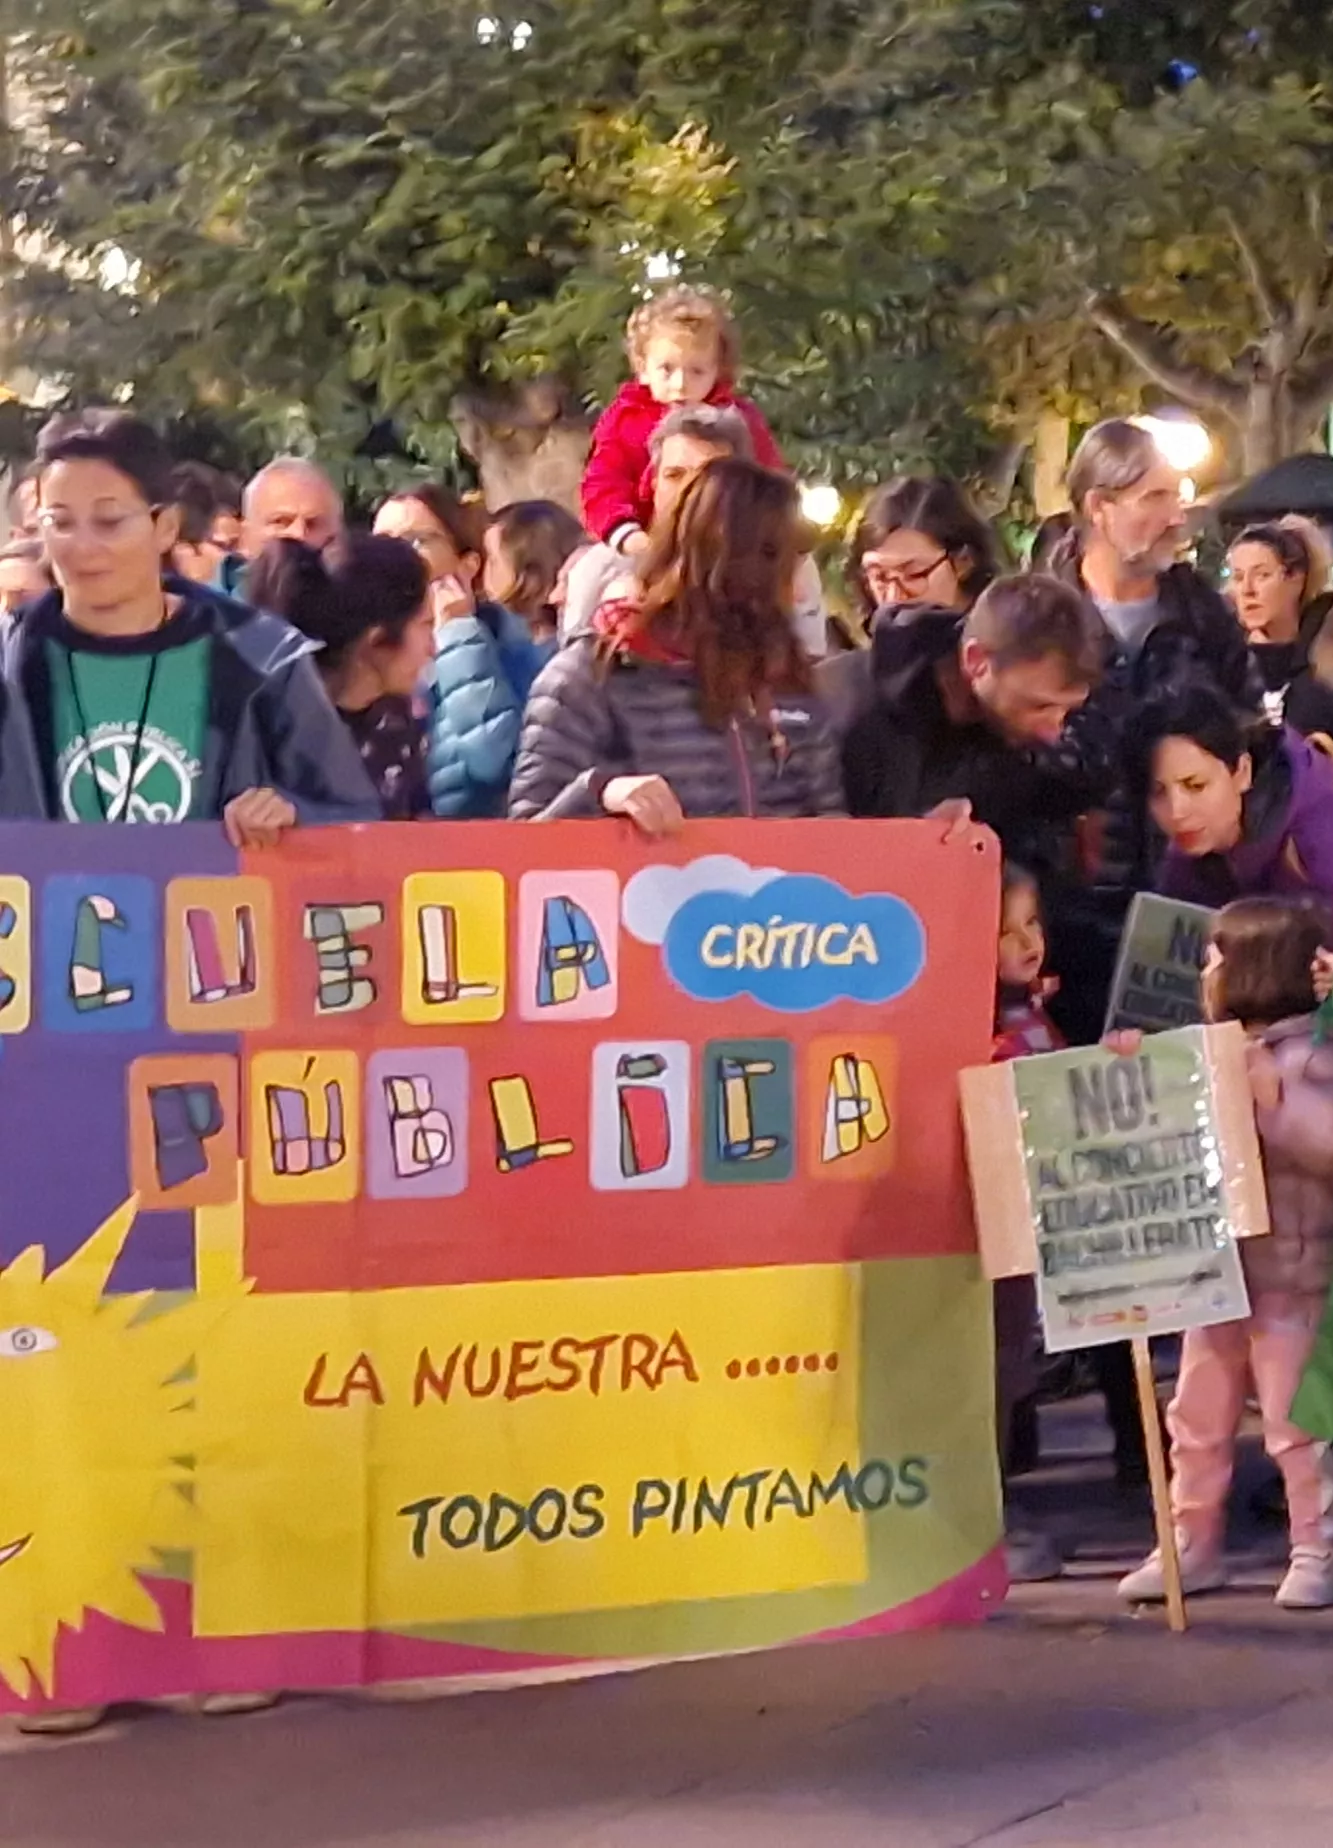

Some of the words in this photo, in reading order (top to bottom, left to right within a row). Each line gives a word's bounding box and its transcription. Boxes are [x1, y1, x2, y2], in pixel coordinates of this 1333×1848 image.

[700, 913, 879, 971] CRÍTICA
[148, 1052, 891, 1192] PÚBLICA
[1068, 1053, 1161, 1140] NO!
[303, 1351, 386, 1406] LA
[412, 1329, 700, 1406] NUESTRA
[397, 1481, 608, 1558] TODOS
[631, 1454, 932, 1537] PINTAMOS
